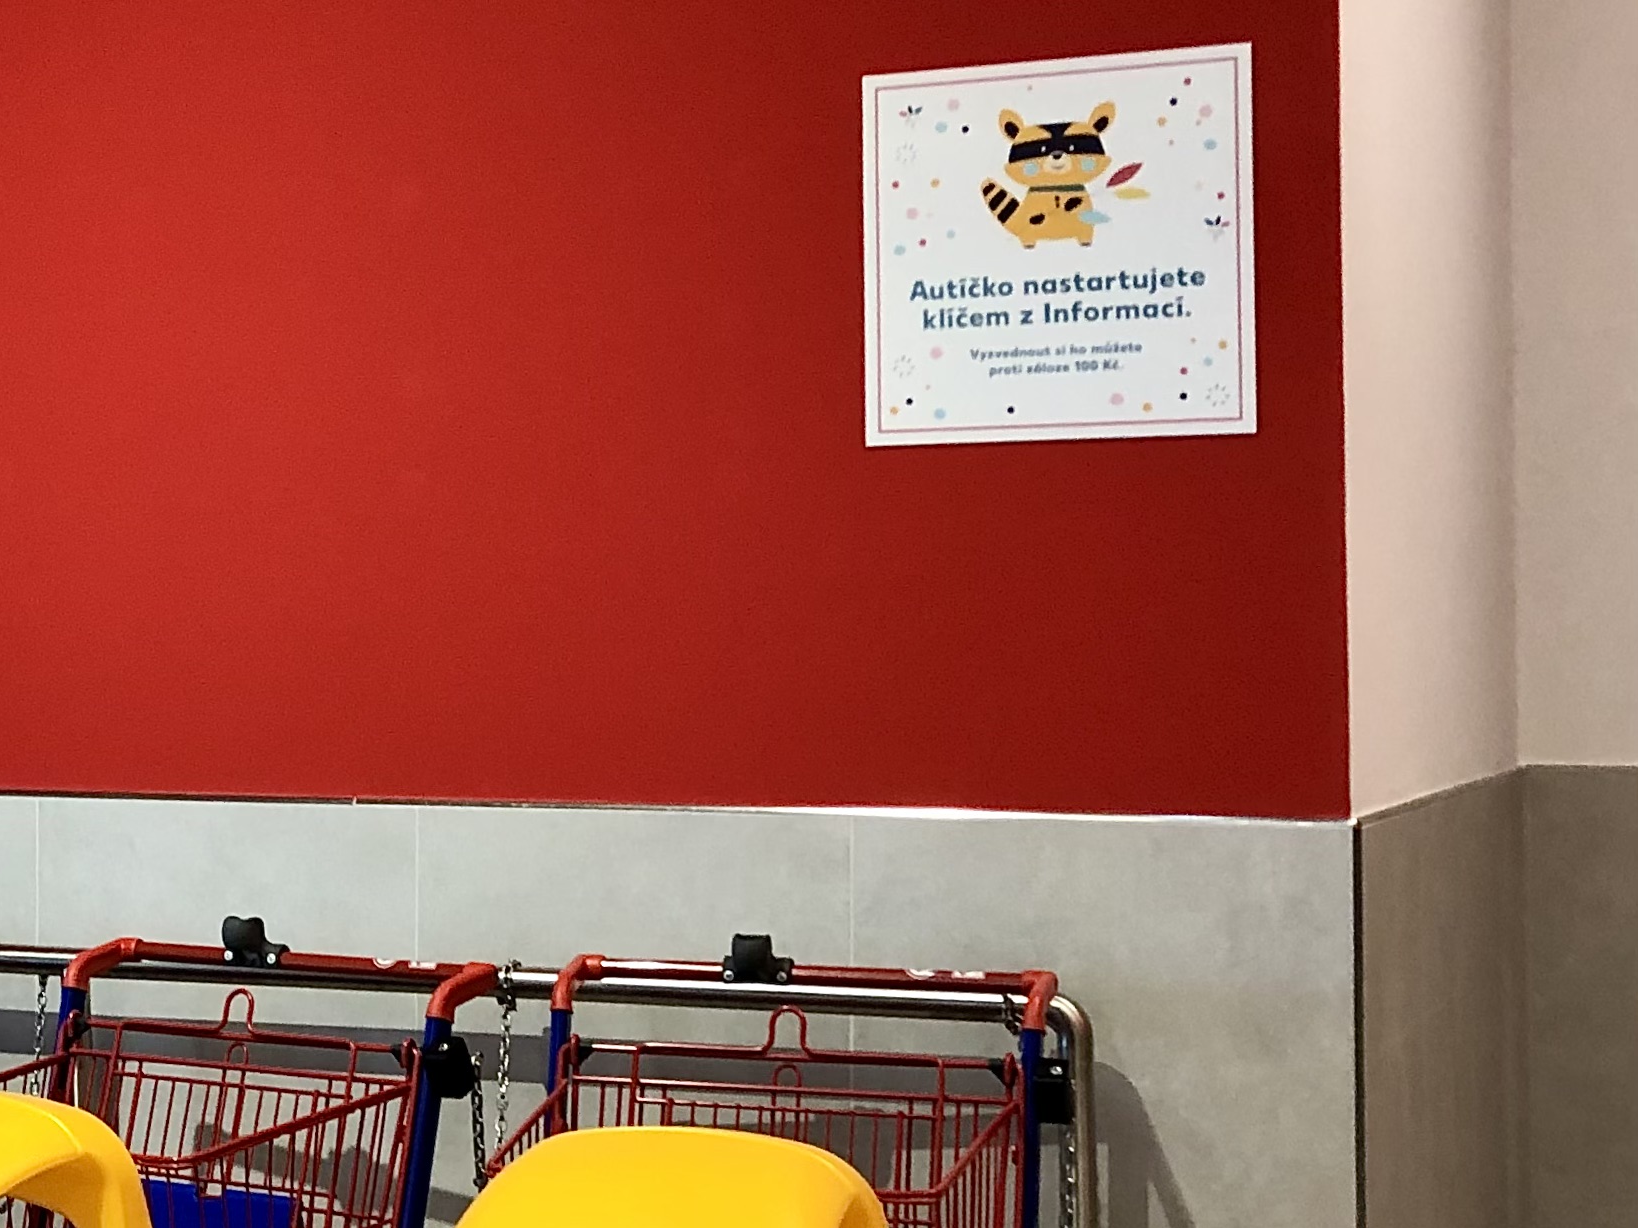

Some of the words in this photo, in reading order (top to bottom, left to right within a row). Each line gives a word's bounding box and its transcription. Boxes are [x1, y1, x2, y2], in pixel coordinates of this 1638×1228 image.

[910, 276, 1013, 301] Autíčko
[1023, 267, 1206, 295] nastartujete
[922, 307, 1010, 331] klíčem
[1020, 308, 1034, 326] z
[1044, 296, 1193, 325] Informací.
[1075, 360, 1099, 372] 100
